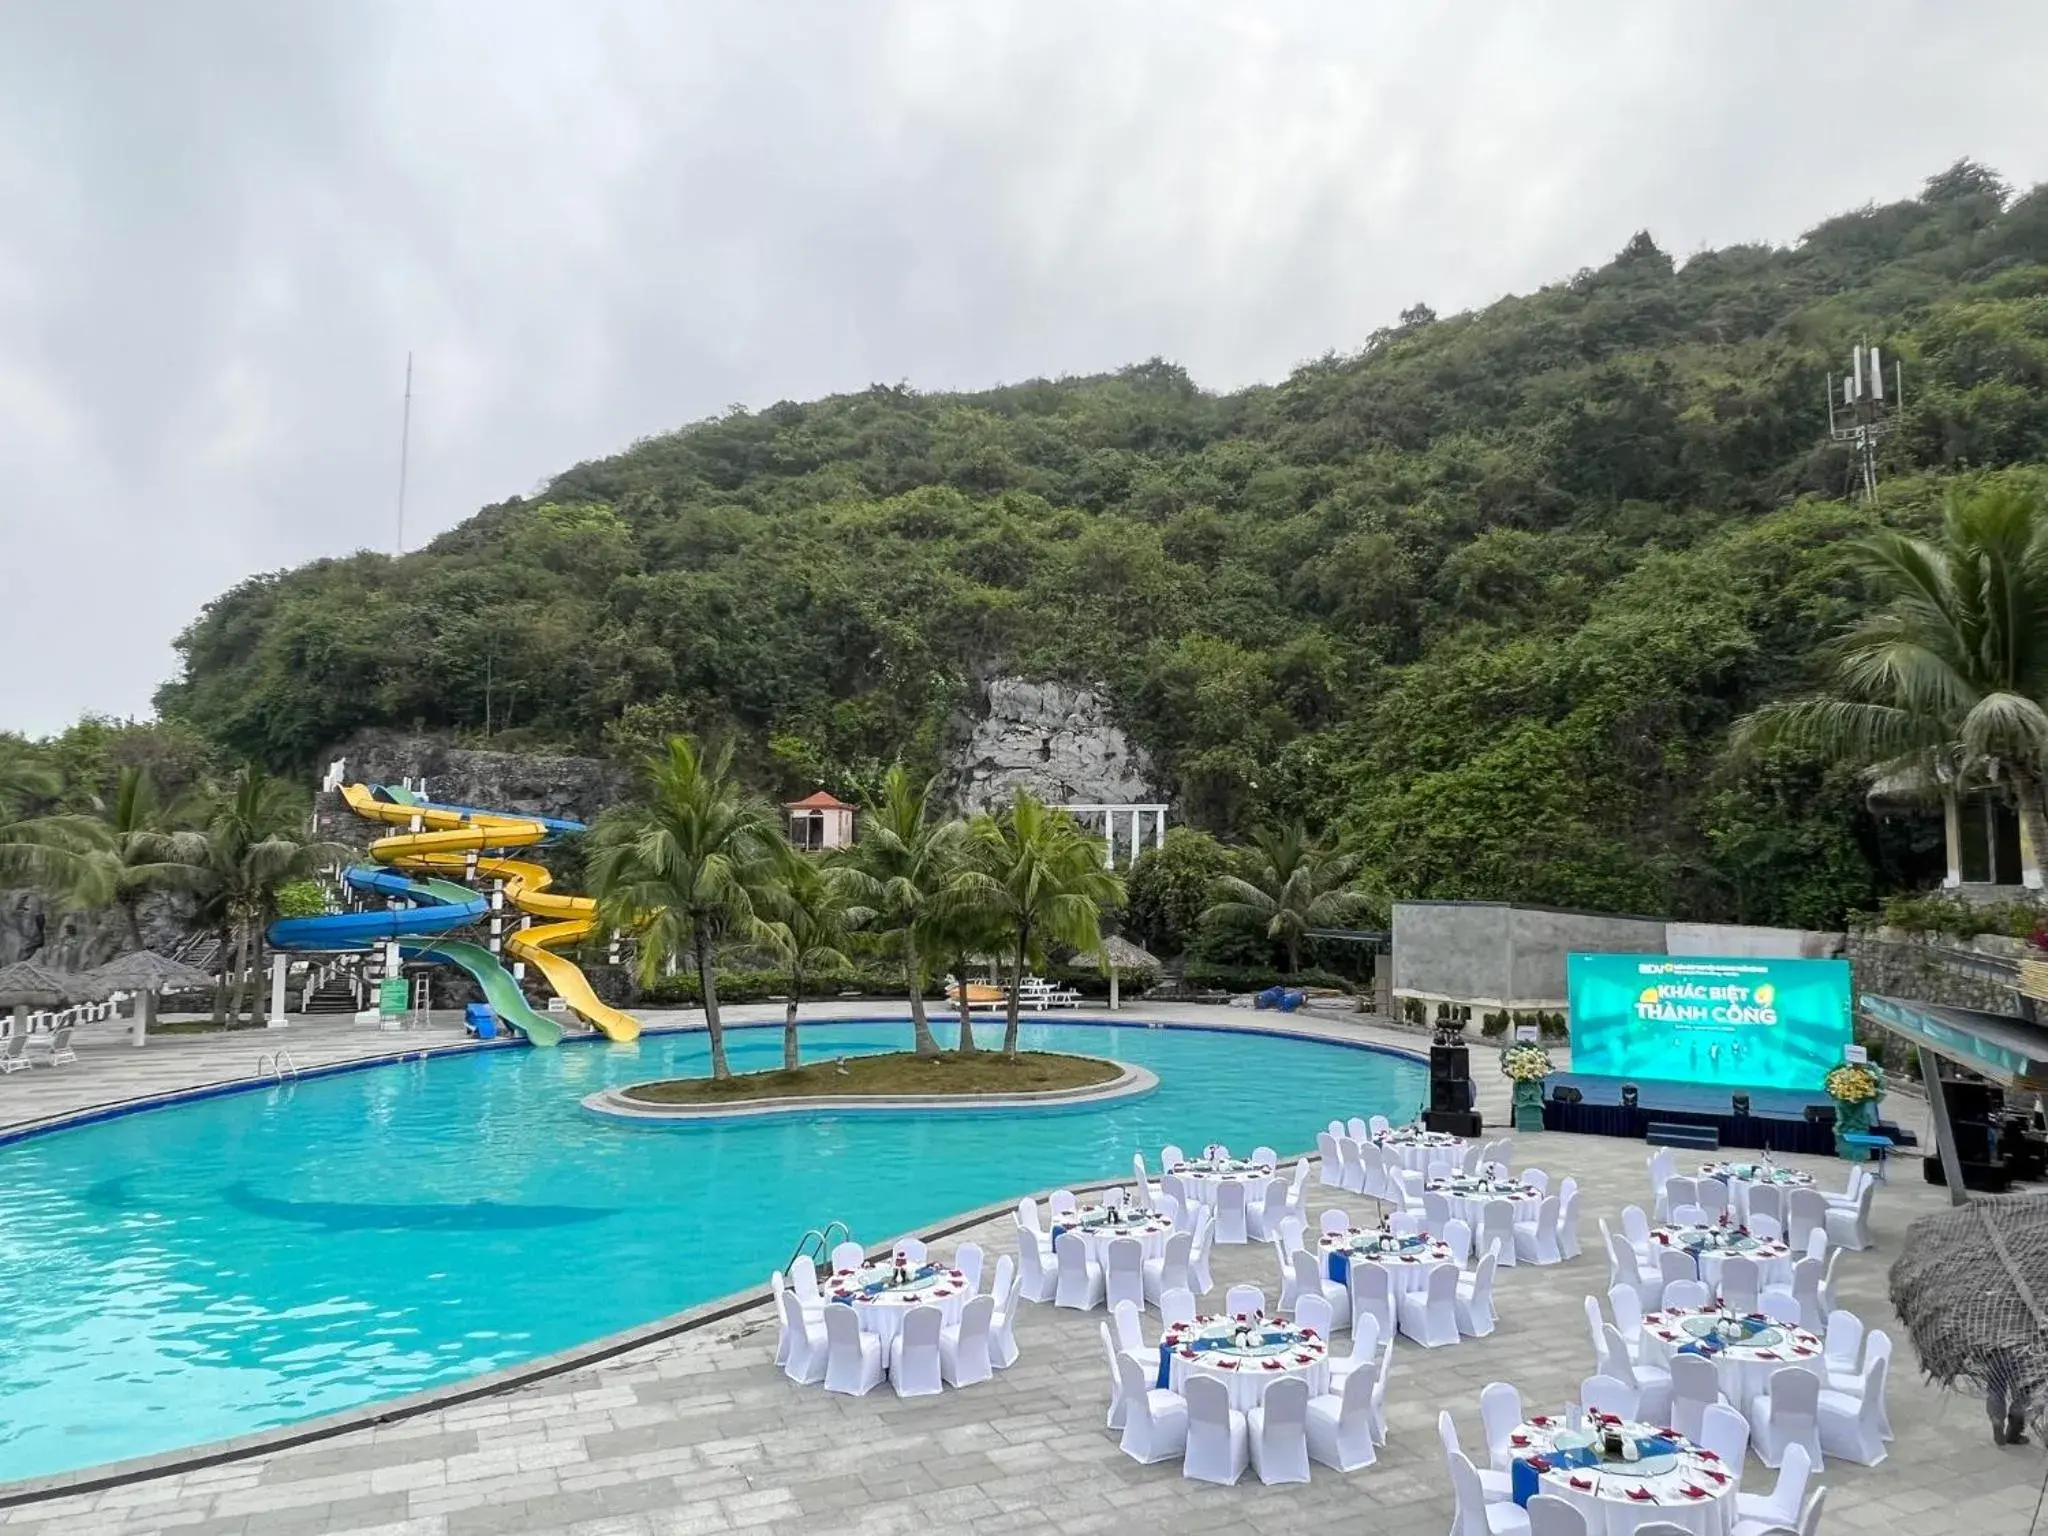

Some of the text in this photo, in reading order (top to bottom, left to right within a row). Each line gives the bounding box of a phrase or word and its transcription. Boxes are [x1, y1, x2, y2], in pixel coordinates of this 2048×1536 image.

[1657, 984, 1750, 1003] KHÁC BIỆT
[1634, 1001, 1777, 1025] THÀNH CÔNG
